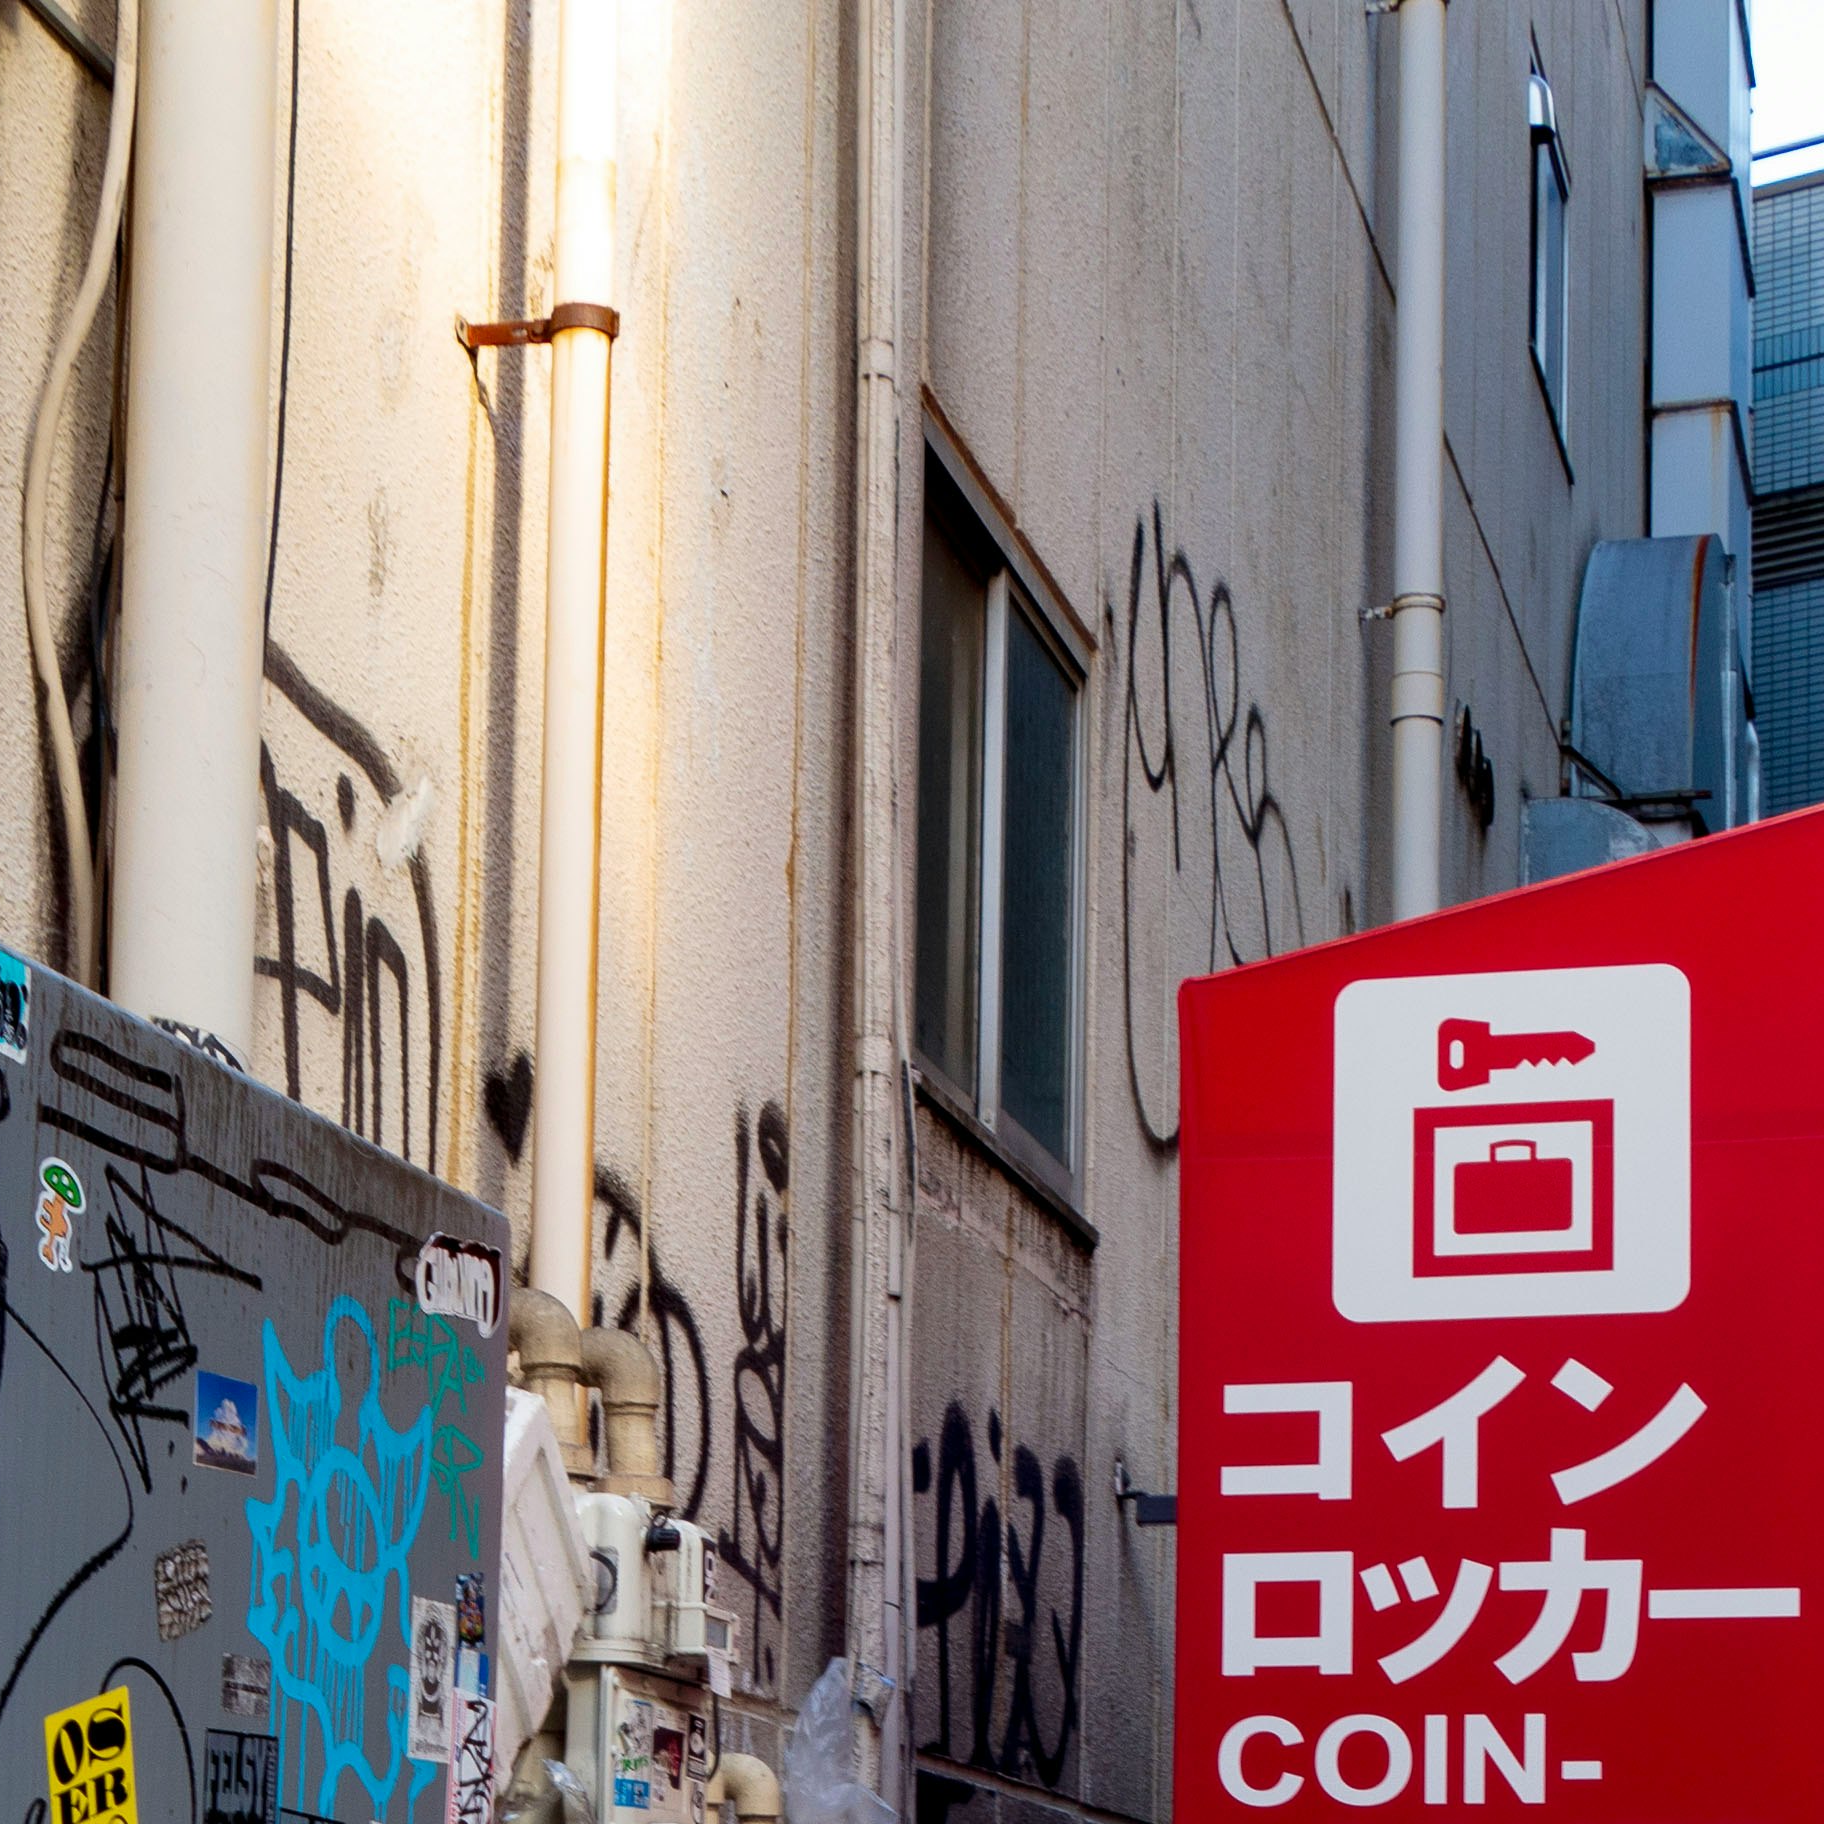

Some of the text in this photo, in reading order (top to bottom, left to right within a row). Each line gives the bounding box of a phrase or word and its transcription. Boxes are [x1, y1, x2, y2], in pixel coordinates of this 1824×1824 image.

[1219, 1355, 1708, 1509] コイン
[1219, 1526, 1802, 1686] ロッカー
[52, 1702, 127, 1786] OS
[1217, 1711, 1604, 1808] COIN-
